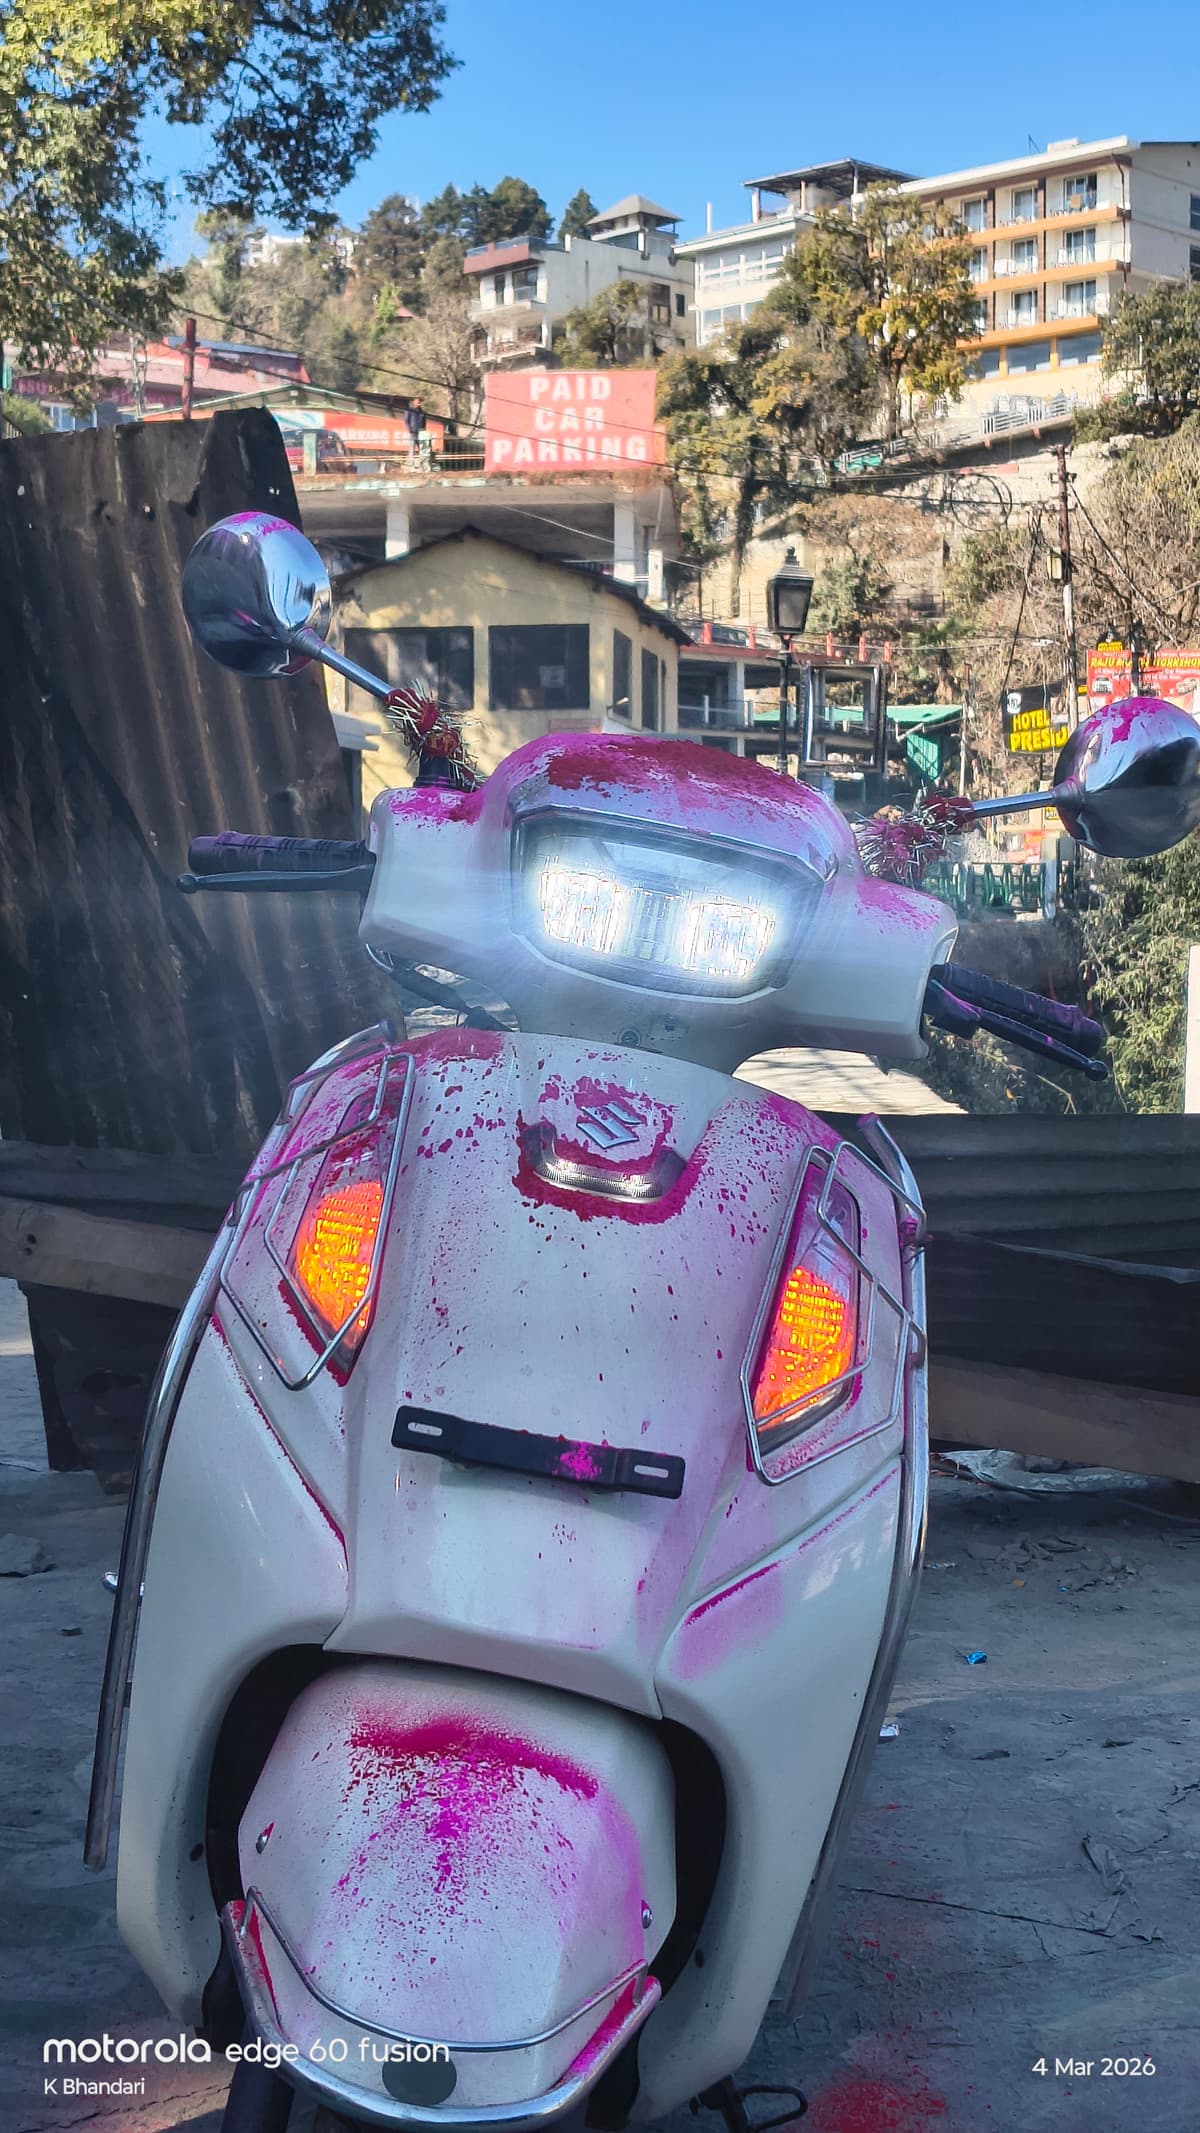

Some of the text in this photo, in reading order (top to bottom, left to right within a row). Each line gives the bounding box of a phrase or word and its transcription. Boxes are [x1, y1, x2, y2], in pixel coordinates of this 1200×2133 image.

[530, 376, 612, 401] PAID
[535, 407, 605, 432] CAR
[492, 436, 647, 463] PARKING
[1090, 657, 1115, 667] RAJU
[1013, 708, 1051, 732] HOTEL
